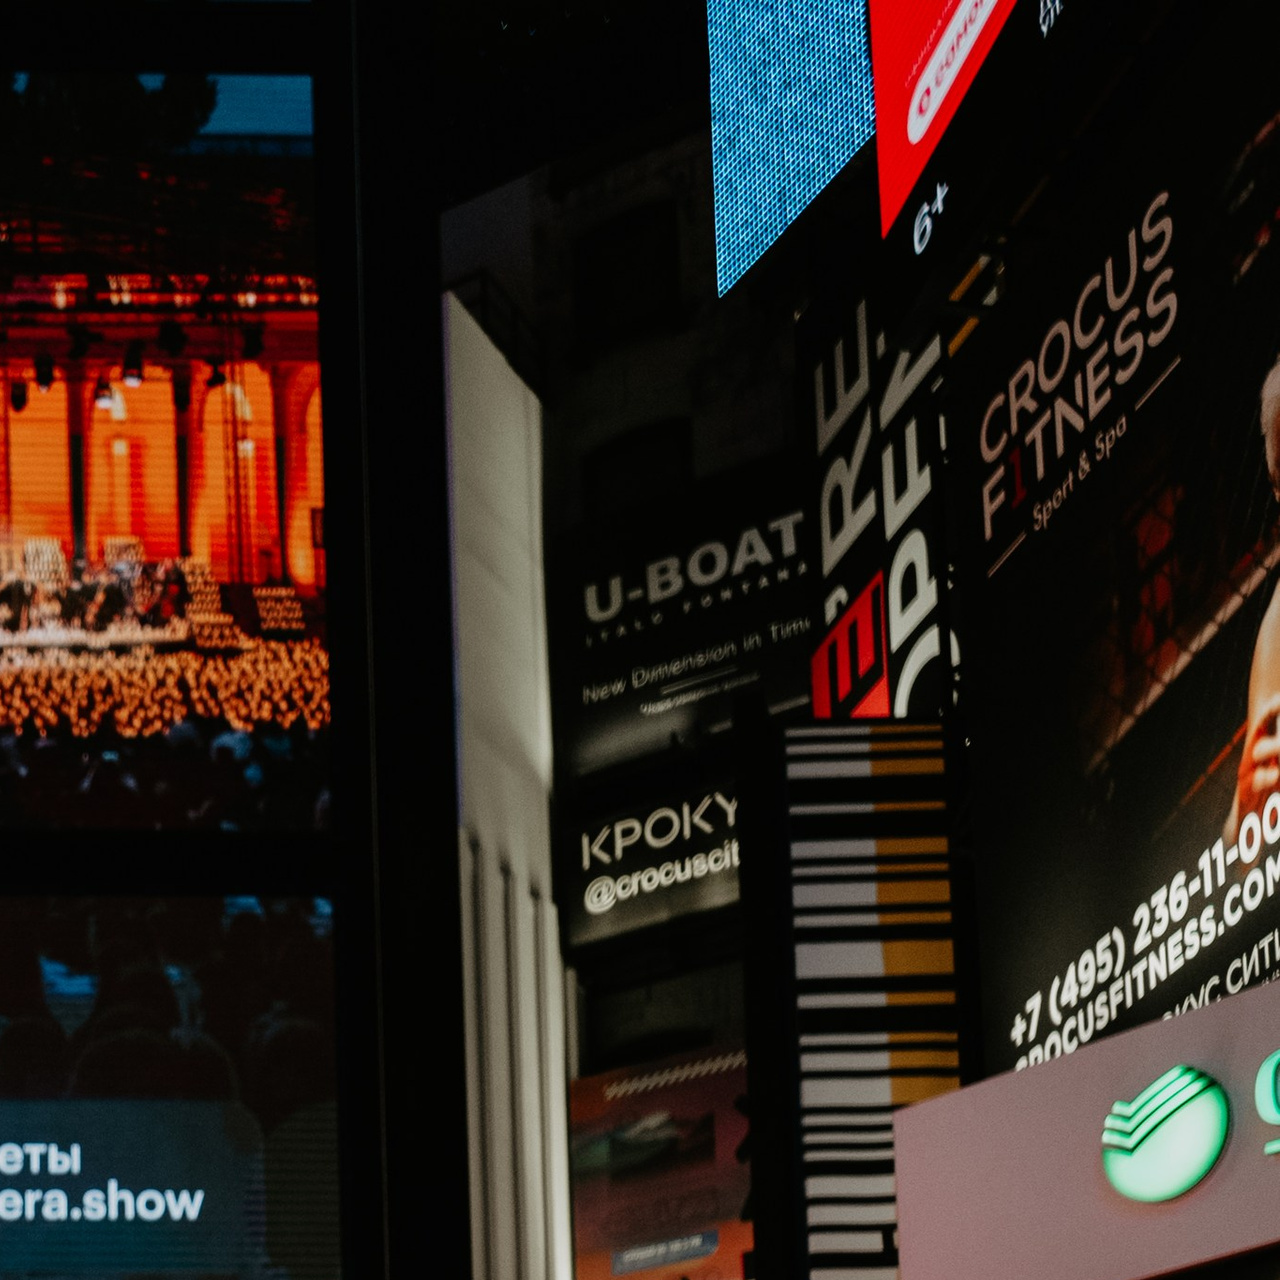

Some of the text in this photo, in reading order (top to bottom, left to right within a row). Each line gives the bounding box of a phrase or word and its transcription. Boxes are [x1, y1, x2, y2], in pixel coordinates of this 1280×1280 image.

[913, 182, 949, 255] 6+
[980, 191, 1173, 465] CROCUS
[1032, 413, 1128, 531] Sport & Spa
[584, 510, 805, 624] U-BOAT
[582, 676, 628, 705] New
[631, 640, 738, 690] Dimension
[743, 632, 762, 650] in
[1010, 990, 1042, 1048] +7
[1048, 926, 1126, 1027] (495)
[1132, 790, 1280, 956] 236-11-00
